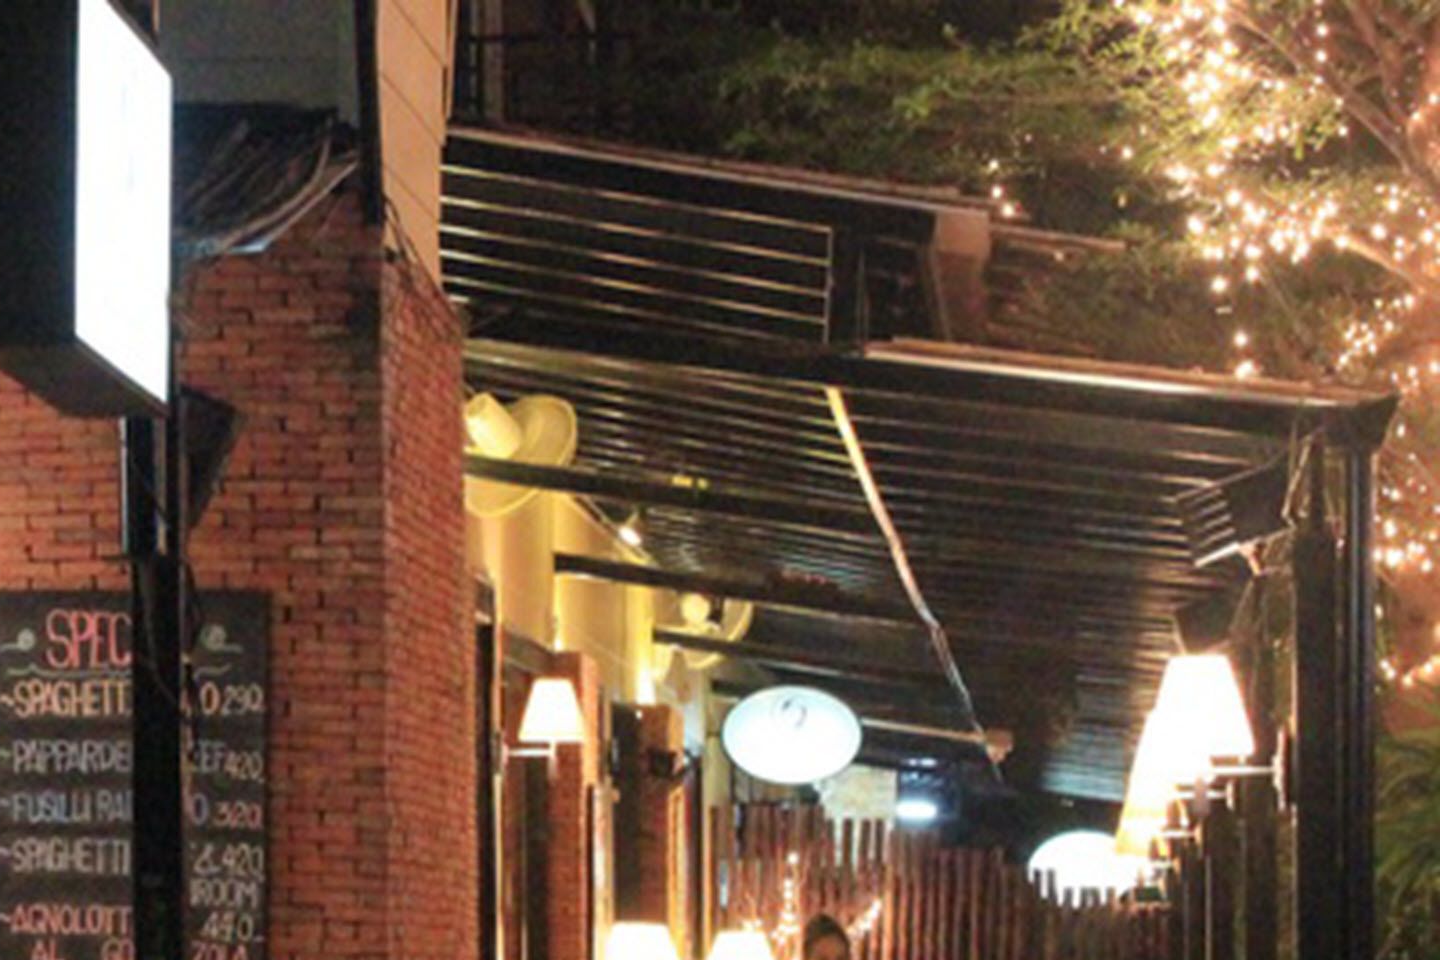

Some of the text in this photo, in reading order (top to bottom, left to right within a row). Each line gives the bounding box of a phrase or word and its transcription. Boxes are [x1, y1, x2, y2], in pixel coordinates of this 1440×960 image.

[45, 608, 133, 668] SPEC
[13, 678, 133, 717] SPAGHETT
[12, 838, 132, 875] SPAGHETTI
[10, 902, 133, 936] AGNOLOTT
